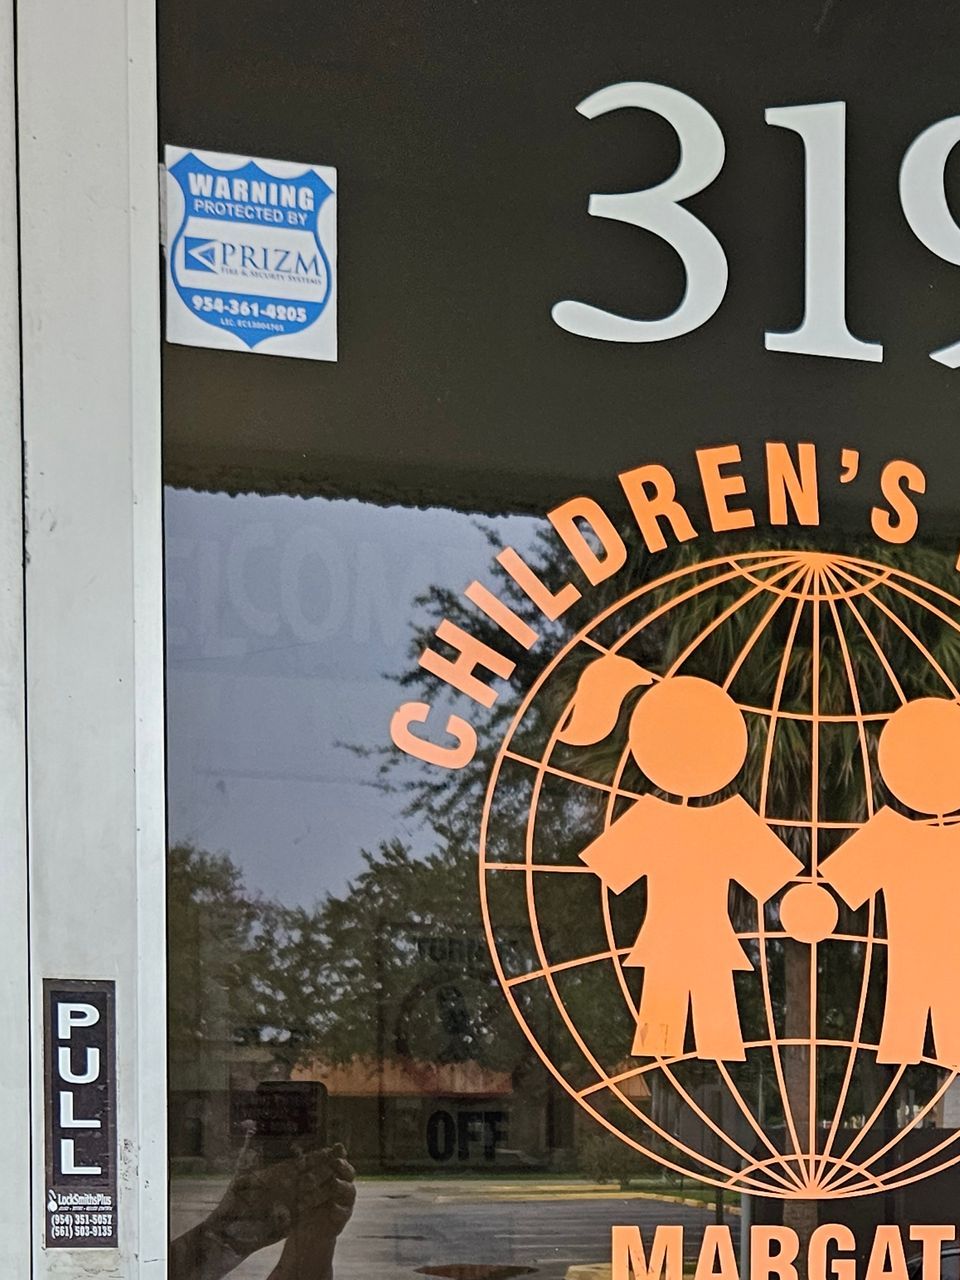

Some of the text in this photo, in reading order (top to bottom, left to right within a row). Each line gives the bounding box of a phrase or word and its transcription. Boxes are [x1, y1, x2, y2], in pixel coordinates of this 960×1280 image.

[188, 172, 314, 212] WARNING
[194, 199, 307, 226] PROTECTED BY
[221, 243, 321, 277] PRIZM
[192, 295, 307, 323] 954-361-4205
[390, 442, 926, 769] CHILDREN'S
[58, 1003, 101, 1174] PULL
[426, 1109, 508, 1162] OFF
[51, 1214, 112, 1227] (954) 351-5057
[51, 1226, 112, 1239] (561) 503-9135
